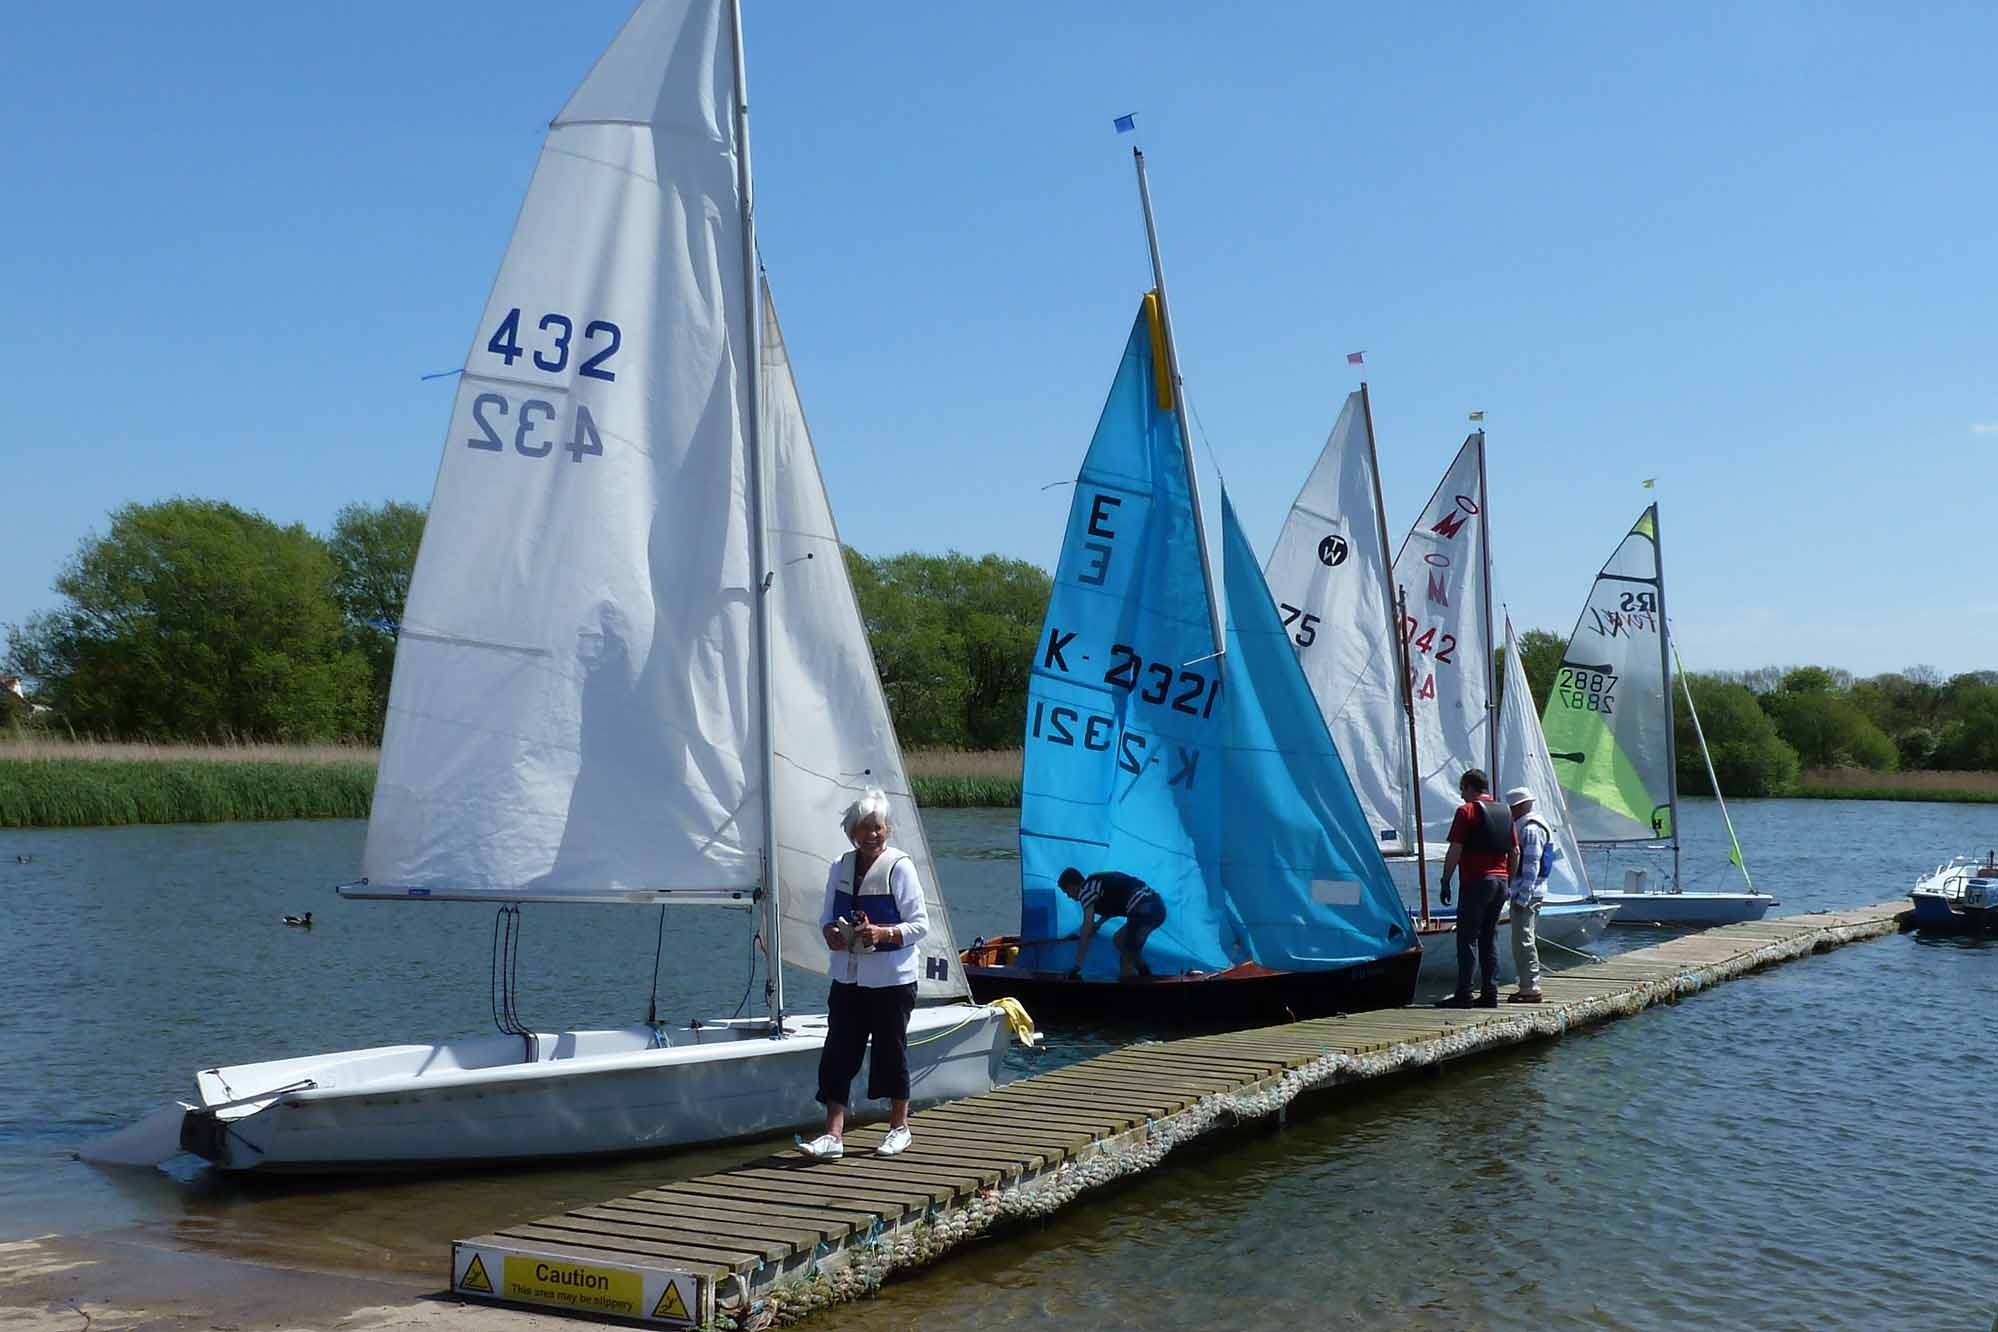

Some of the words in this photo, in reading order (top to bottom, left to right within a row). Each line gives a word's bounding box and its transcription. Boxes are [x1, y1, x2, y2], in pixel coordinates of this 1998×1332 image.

[488, 308, 621, 382] 432
[1088, 494, 1121, 539] E
[1560, 669, 1618, 694] 2887
[535, 1263, 609, 1290] Caution
[512, 1283, 532, 1295] This
[557, 1291, 578, 1305] may
[580, 1294, 592, 1303] be
